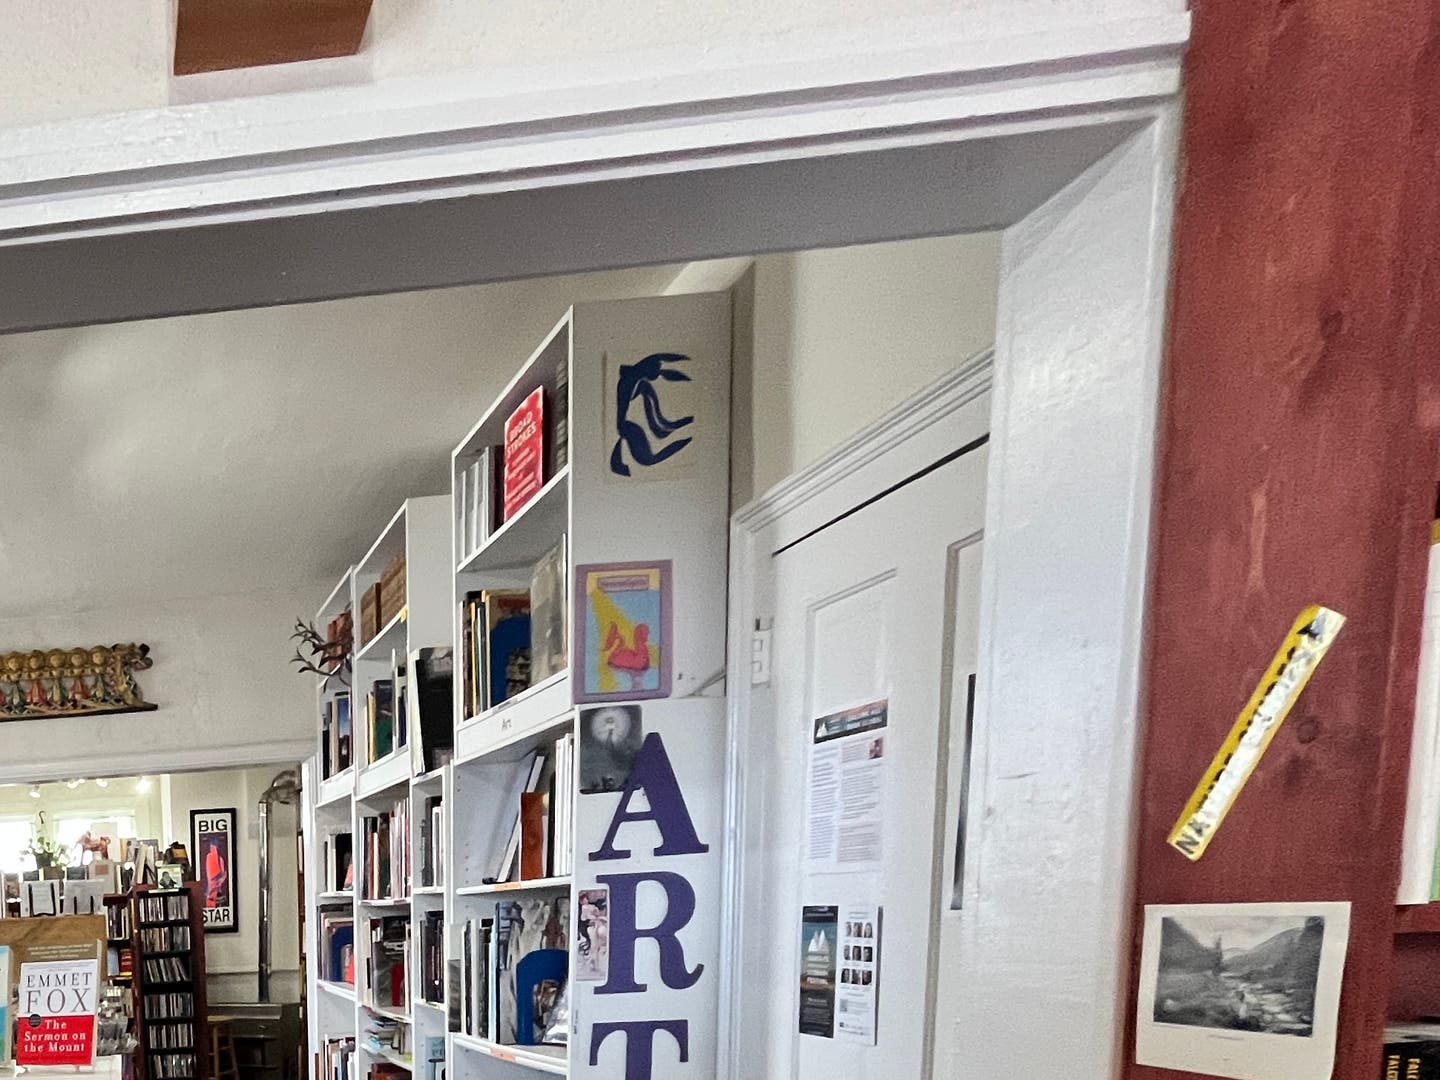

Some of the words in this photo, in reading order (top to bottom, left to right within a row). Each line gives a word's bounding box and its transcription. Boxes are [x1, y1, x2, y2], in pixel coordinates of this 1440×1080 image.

[199, 819, 228, 832] BIG
[202, 909, 230, 923] STAR
[27, 972, 92, 988] EMMET
[26, 988, 90, 1014] FOX
[45, 1019, 67, 1030] The
[24, 1031, 68, 1041] Sermon
[72, 1032, 86, 1040] on
[24, 1043, 44, 1052] the
[48, 1043, 85, 1052] Mount
